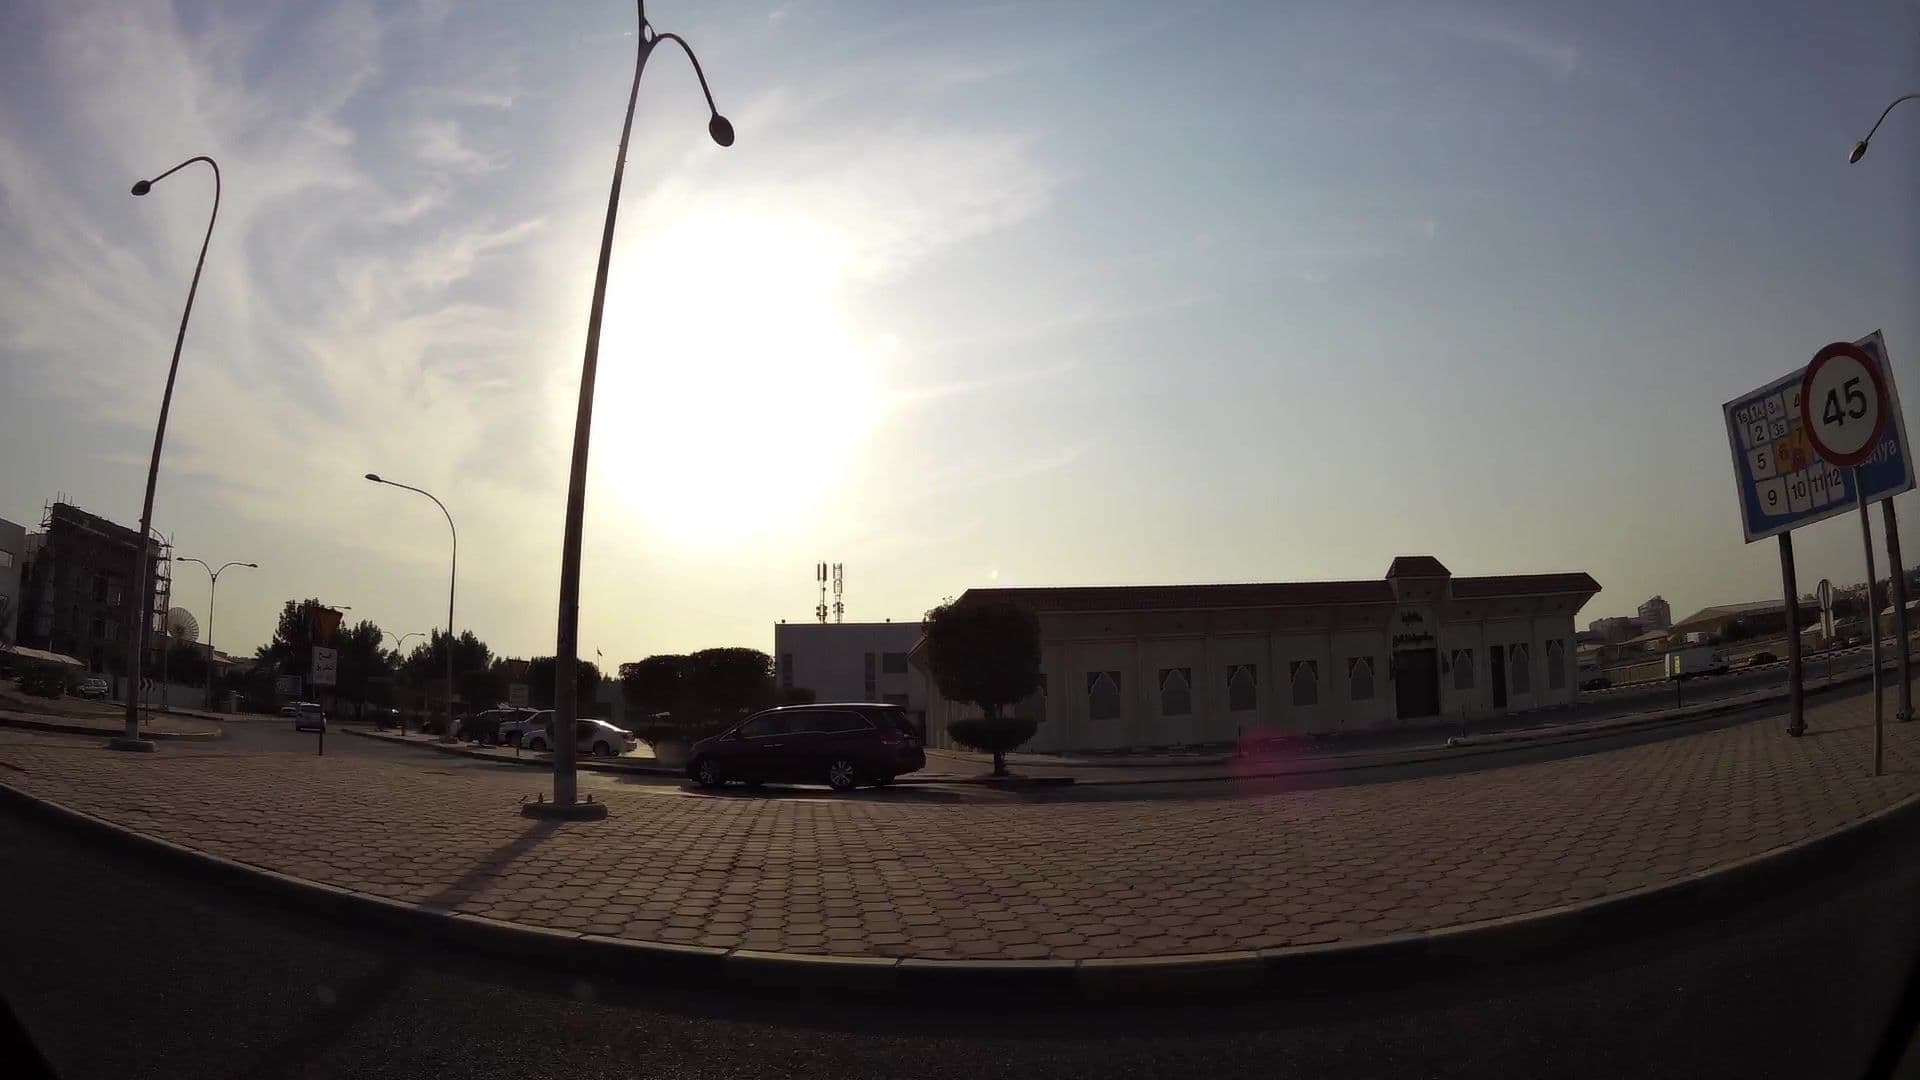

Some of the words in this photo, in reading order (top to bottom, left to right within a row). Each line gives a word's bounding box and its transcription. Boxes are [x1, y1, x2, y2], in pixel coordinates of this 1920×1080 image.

[1823, 377, 1867, 427] 45
[1755, 425, 1765, 442] 2
[1757, 452, 1766, 470] 5
[1811, 474, 1824, 493] 11
[1827, 468, 1841, 487] 12
[1767, 489, 1777, 506] 9
[1791, 481, 1806, 500] 10
